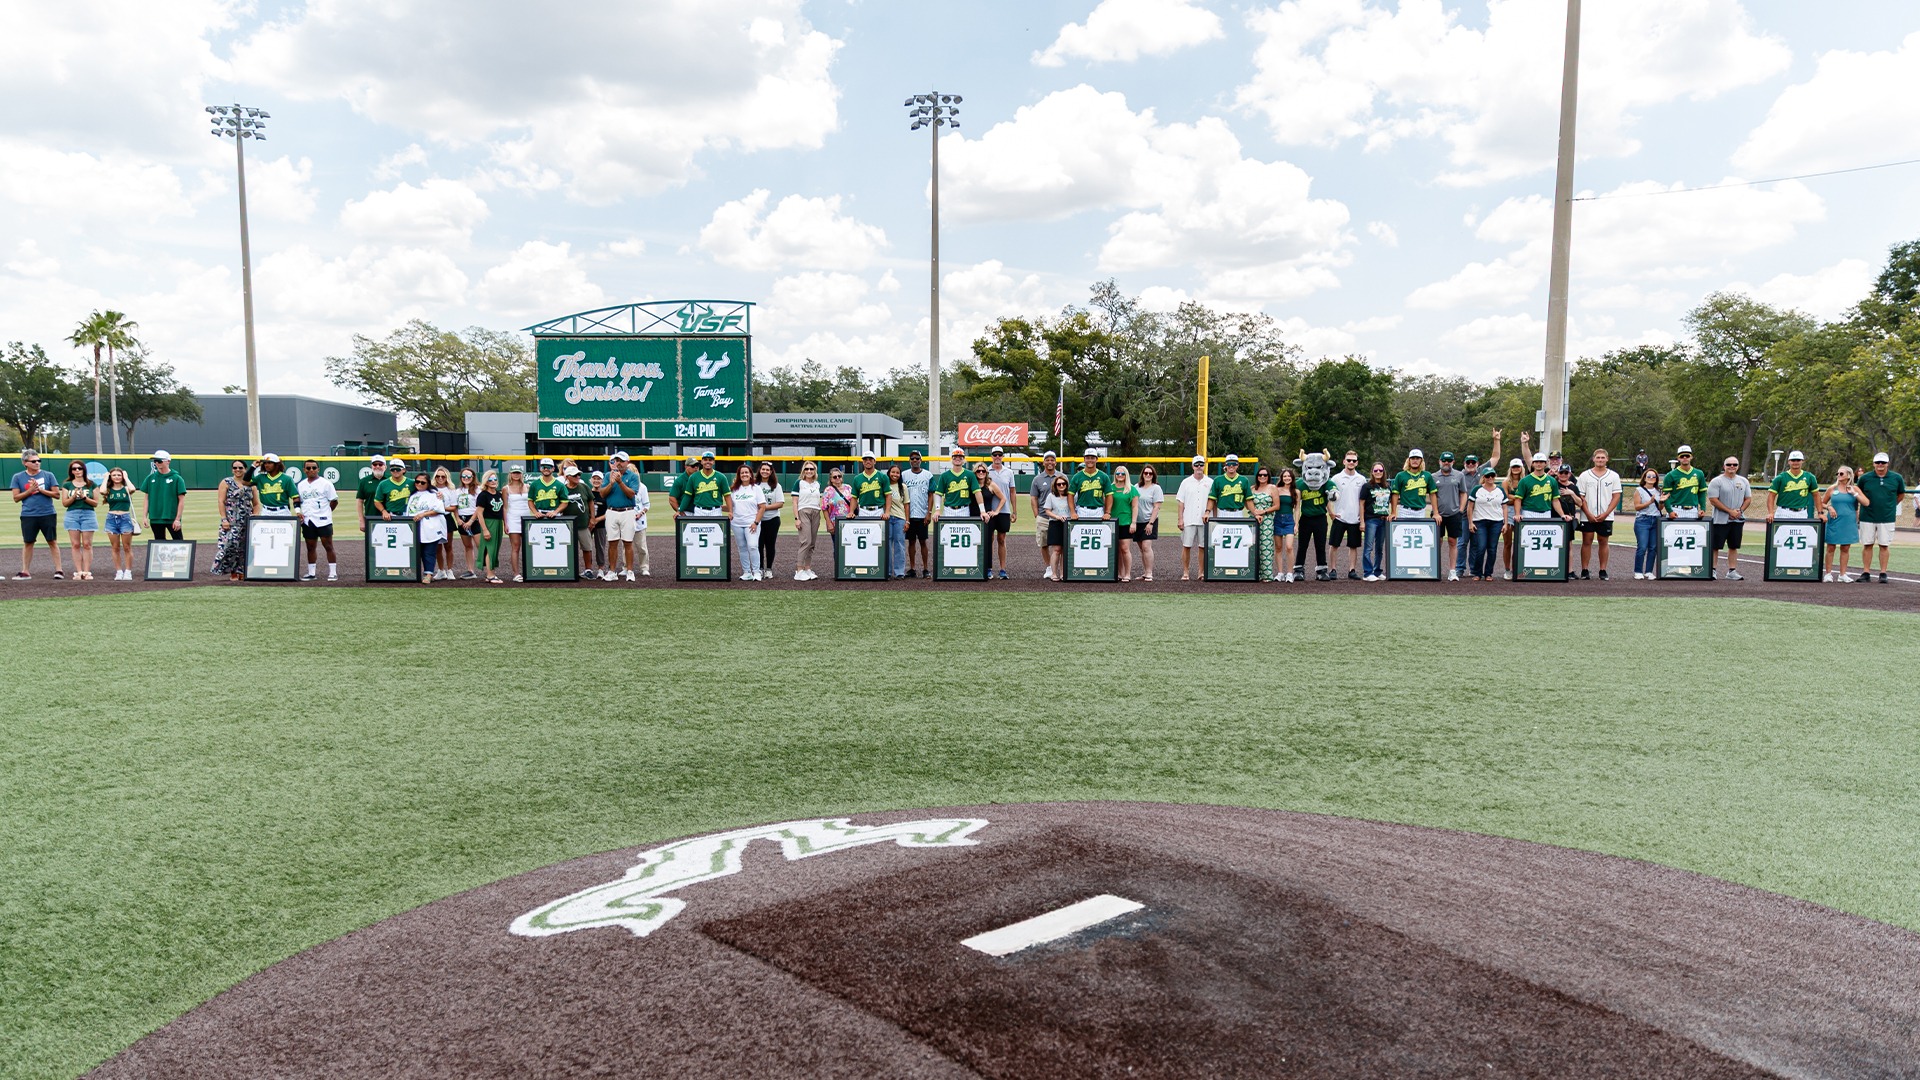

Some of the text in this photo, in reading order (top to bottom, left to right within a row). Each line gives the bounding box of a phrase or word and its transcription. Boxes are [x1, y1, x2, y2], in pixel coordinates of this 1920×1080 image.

[676, 304, 744, 333] USF
[553, 351, 664, 386] Thank you,
[565, 377, 653, 405] Seniors!
[693, 385, 726, 400] Tampa
[710, 396, 734, 408] Bay
[552, 423, 621, 437] @USFBASEBALL
[674, 424, 716, 437] 12:41 PM
[964, 424, 1022, 444] Coca-Cola
[292, 471, 297, 479] 7
[327, 471, 336, 480] 36
[269, 535, 275, 549] 1
[388, 535, 397, 548] 2
[545, 536, 555, 549] 3
[699, 534, 708, 547] 5
[857, 536, 867, 549] 6
[950, 534, 971, 548] 20
[1080, 536, 1101, 549] 26
[1222, 535, 1242, 549] 27
[1402, 535, 1423, 548] 32
[1531, 537, 1553, 550] 34
[1673, 536, 1696, 549] 42
[1783, 536, 1807, 549] 45
